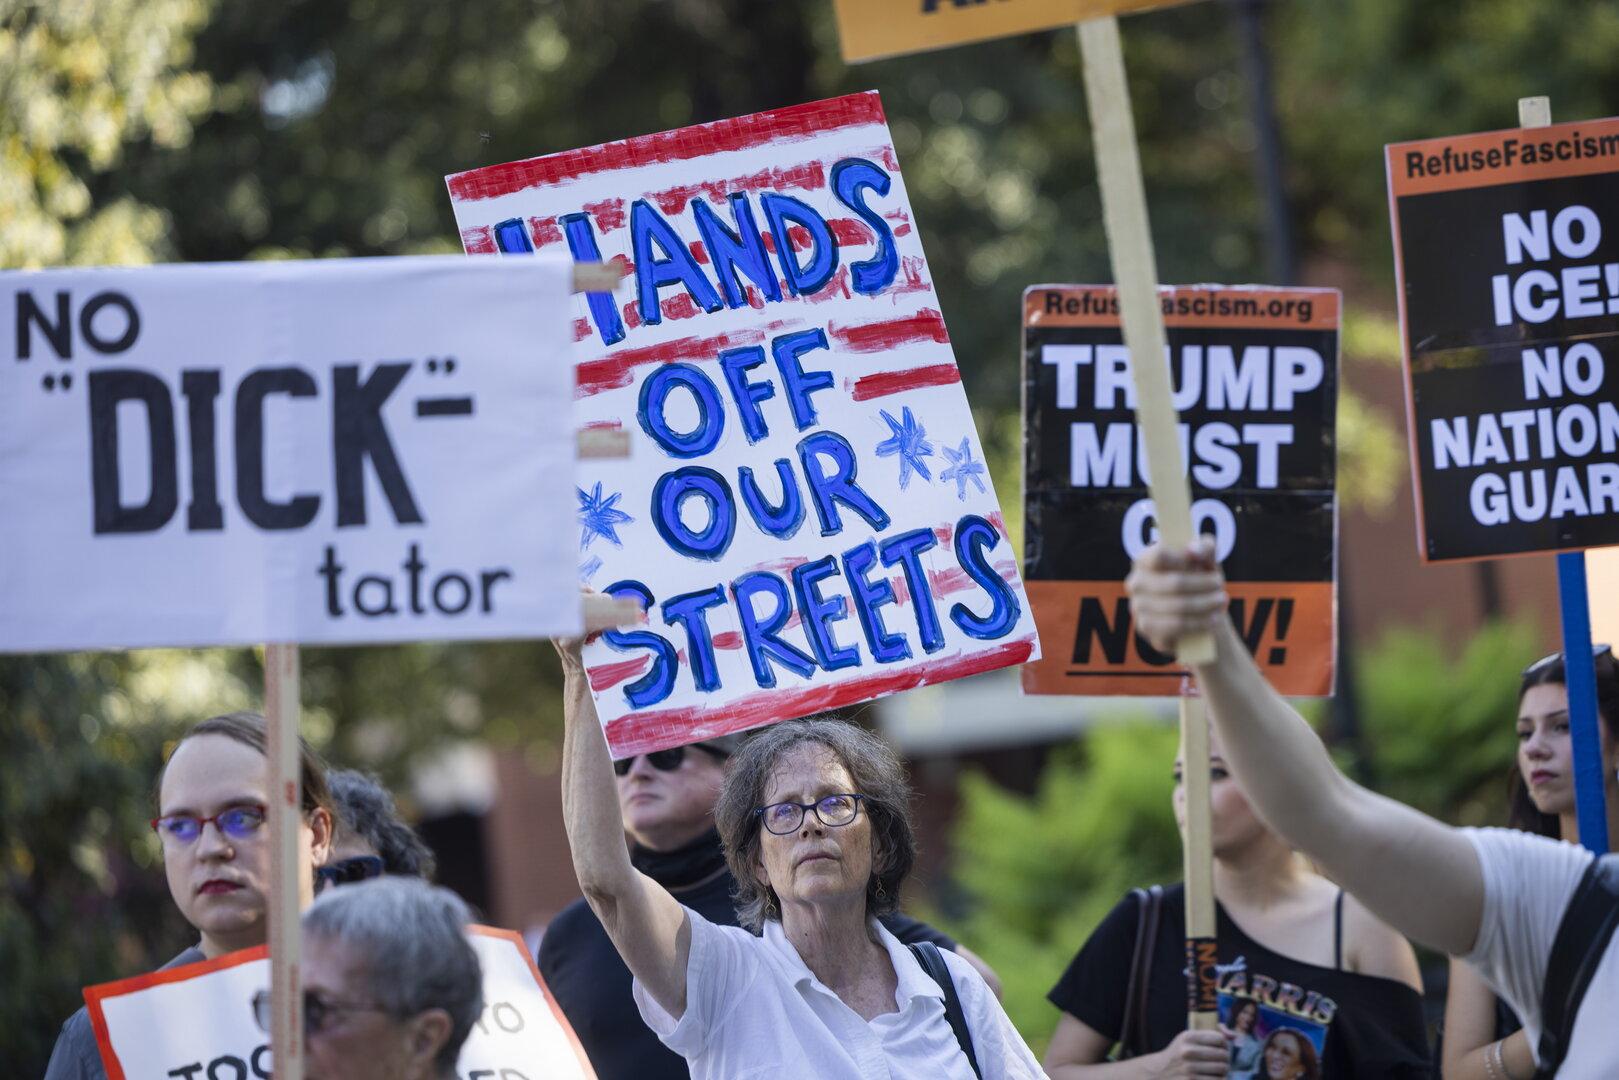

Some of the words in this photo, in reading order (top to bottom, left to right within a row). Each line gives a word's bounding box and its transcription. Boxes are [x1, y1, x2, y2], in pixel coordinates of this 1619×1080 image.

[1502, 205, 1602, 265] NO
[14, 290, 141, 361] NO
[1045, 291, 1313, 323] Refusascism.org
[1492, 263, 1619, 326] ICE!
[637, 327, 835, 459] OFF
[1041, 344, 1325, 411] TRUMP
[1522, 342, 1604, 401] NO
[650, 430, 892, 562] OUR
[1469, 462, 1619, 526] GUAR
[317, 542, 512, 618] tator
[599, 514, 1022, 710] STREETS
[1071, 596, 1296, 667] N!
[1216, 971, 1338, 1025] ARRIS
